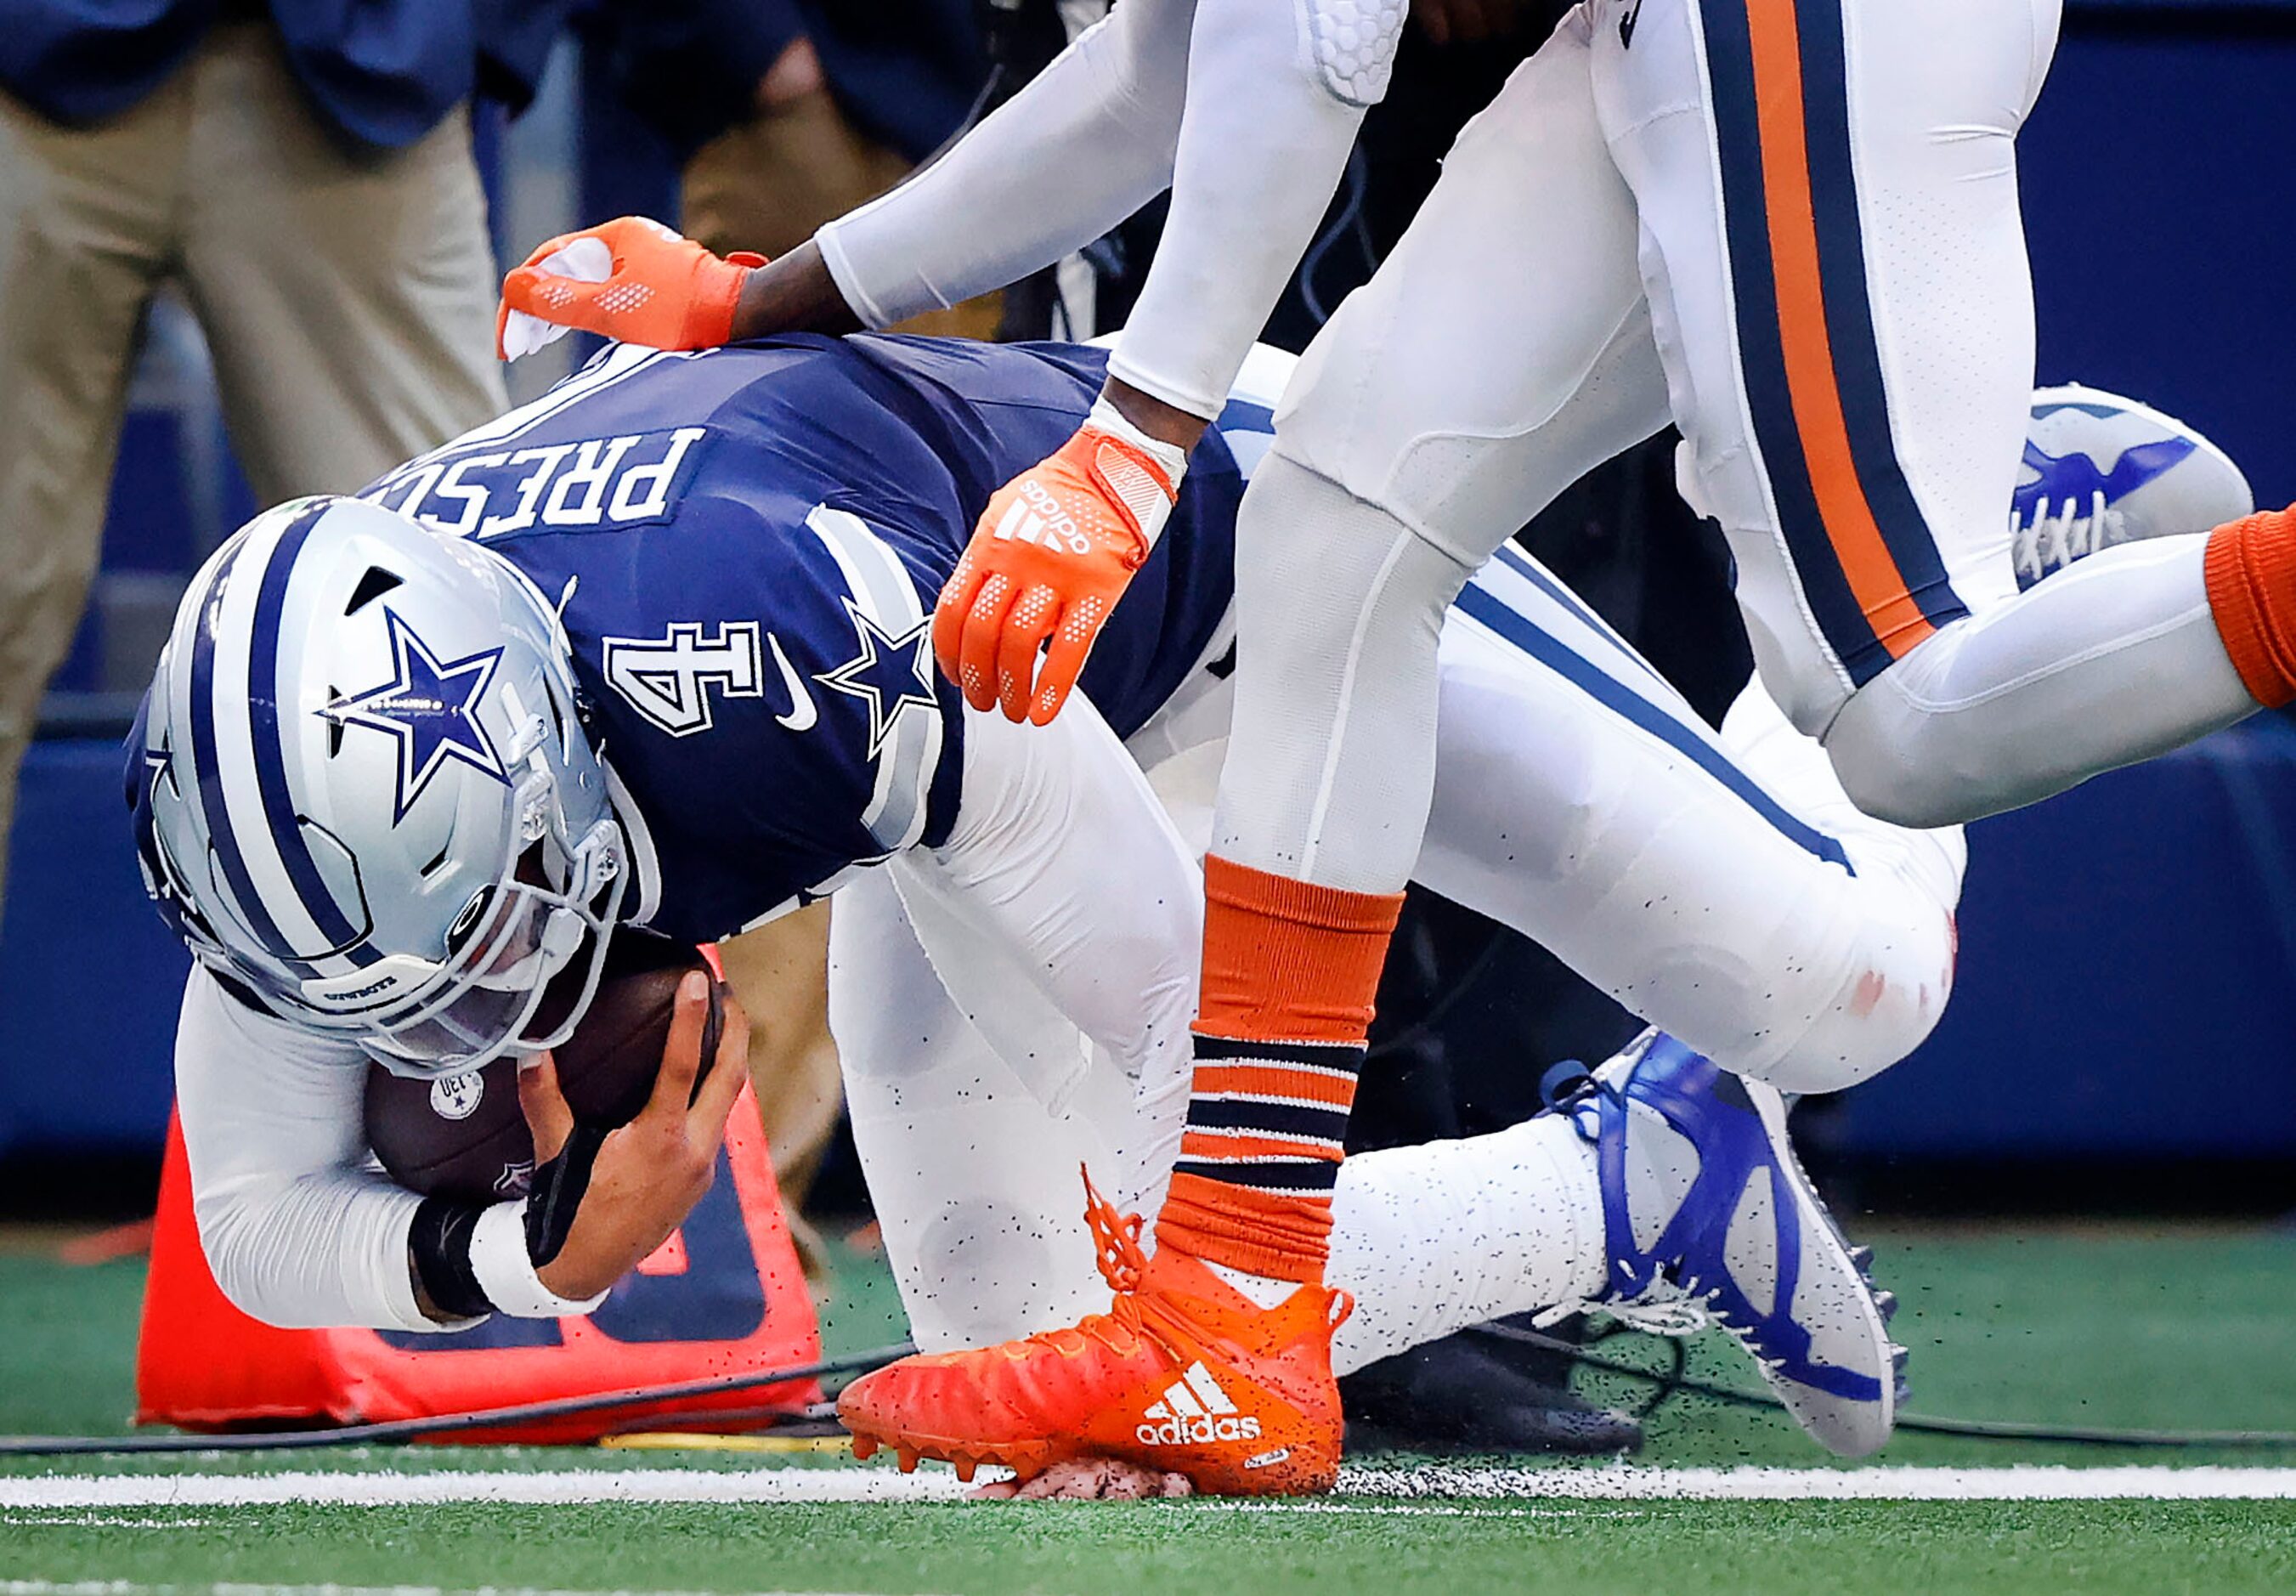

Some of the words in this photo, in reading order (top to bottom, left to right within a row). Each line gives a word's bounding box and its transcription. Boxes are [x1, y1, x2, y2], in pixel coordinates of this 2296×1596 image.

[377, 428, 706, 539] PRESC
[1021, 479, 1091, 555] adidas
[602, 620, 763, 739] 4
[1135, 1412, 1262, 1446] adidas
